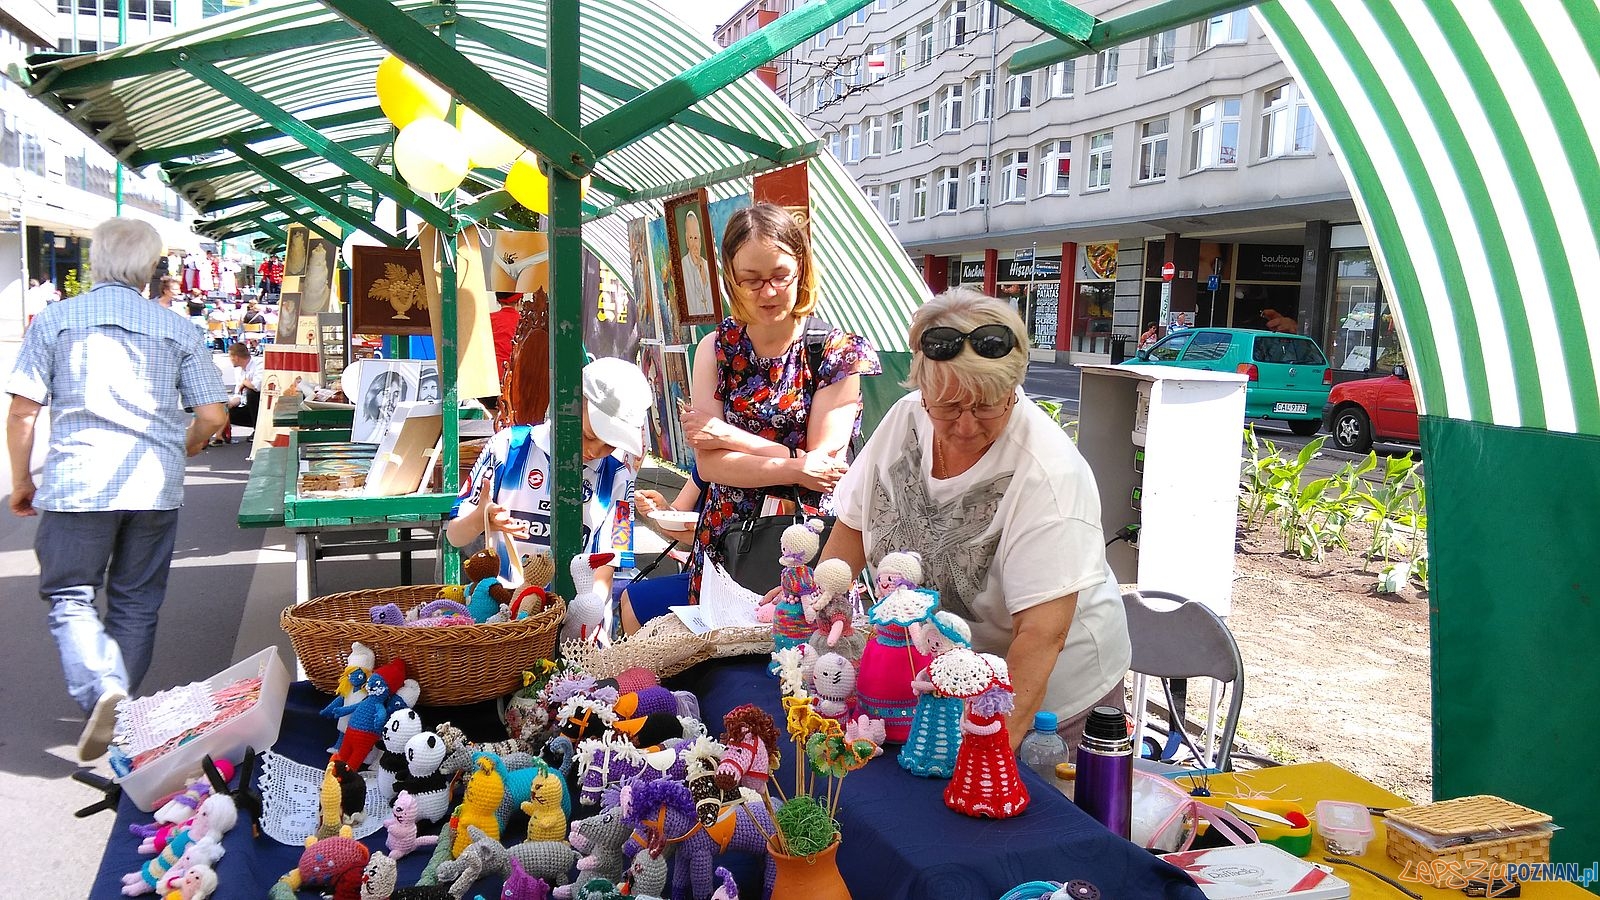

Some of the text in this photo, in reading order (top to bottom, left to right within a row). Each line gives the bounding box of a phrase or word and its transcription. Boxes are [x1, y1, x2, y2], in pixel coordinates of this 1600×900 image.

[1261, 254, 1300, 264] boutique
[963, 265, 985, 278] Kuchni
[1036, 289, 1059, 298] PATATAS
